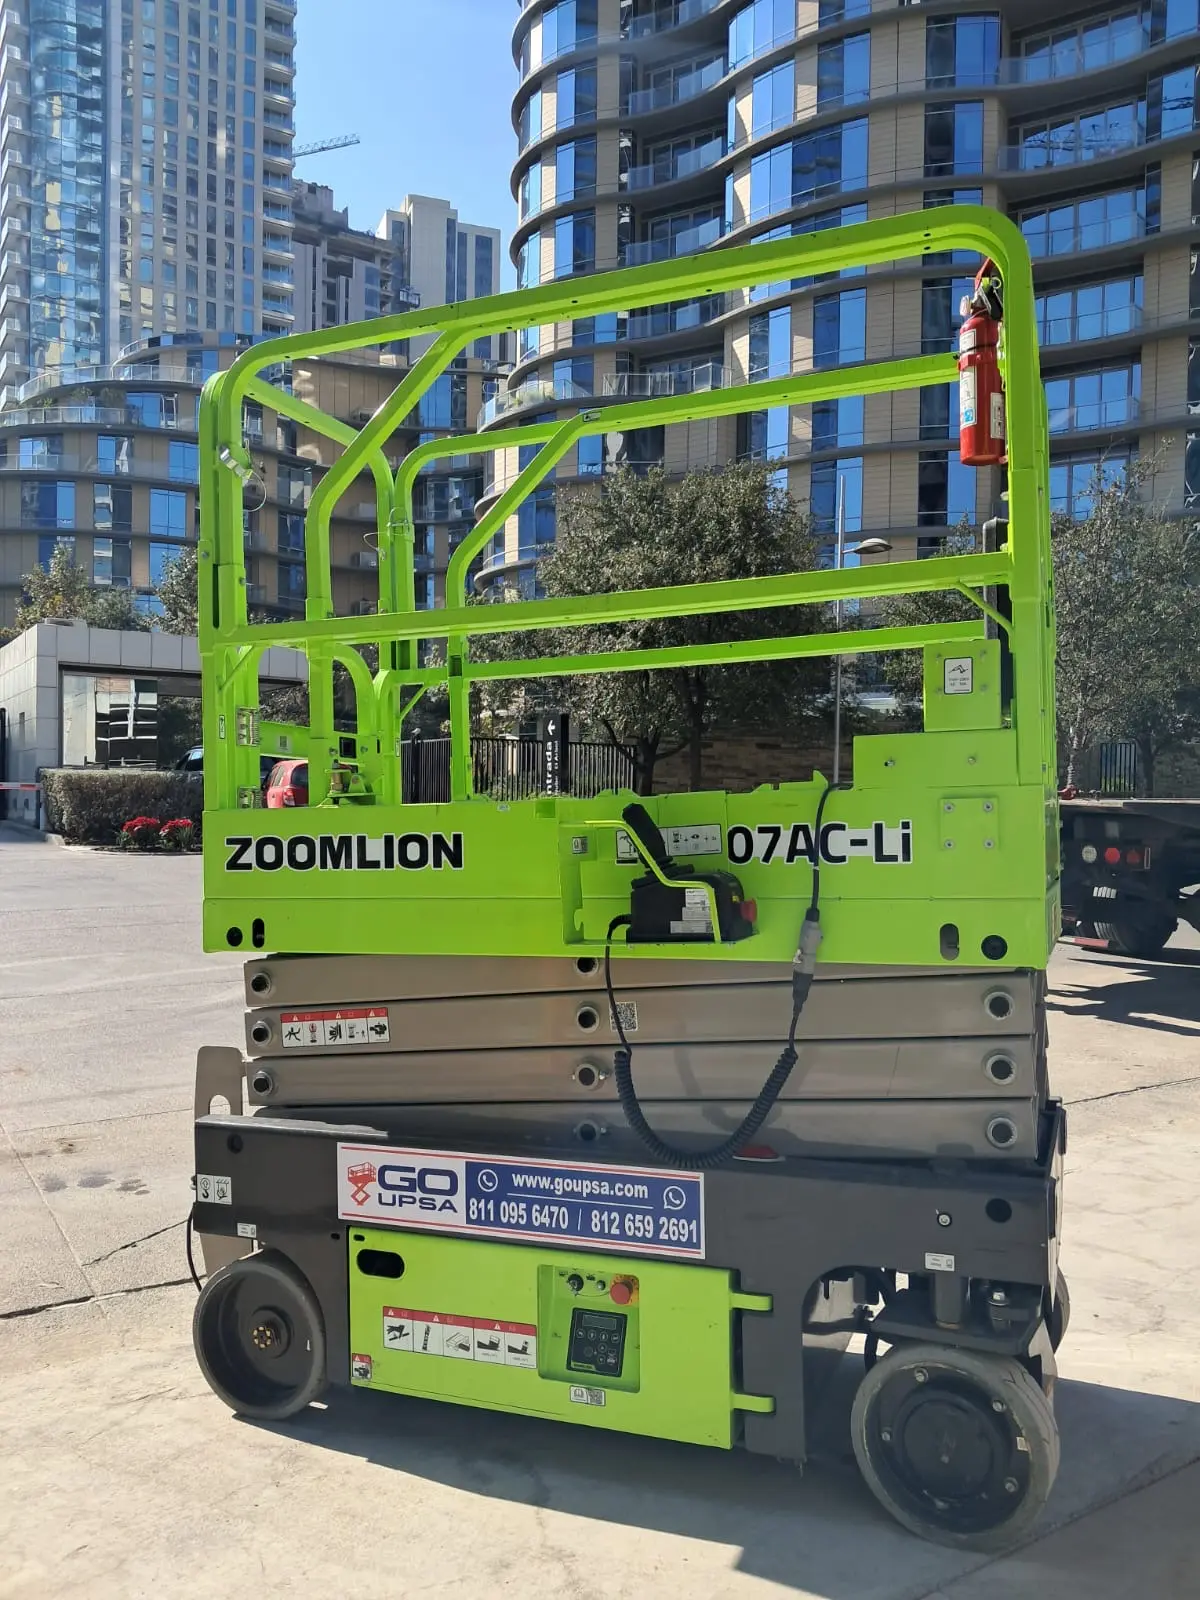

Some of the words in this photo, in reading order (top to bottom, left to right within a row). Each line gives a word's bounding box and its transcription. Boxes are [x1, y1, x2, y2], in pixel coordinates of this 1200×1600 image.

[225, 832, 464, 871] ZOOMLION
[615, 821, 912, 864] 07AC-Li
[377, 1163, 459, 1196] GO
[511, 1172, 649, 1199] www.goupsa.com
[377, 1192, 459, 1213] UPSA
[469, 1199, 495, 1221] 811
[500, 1203, 527, 1225] 095
[531, 1205, 569, 1230] 6470
[591, 1211, 620, 1235] 812
[624, 1214, 654, 1239] 659
[658, 1218, 698, 1244] 2691
